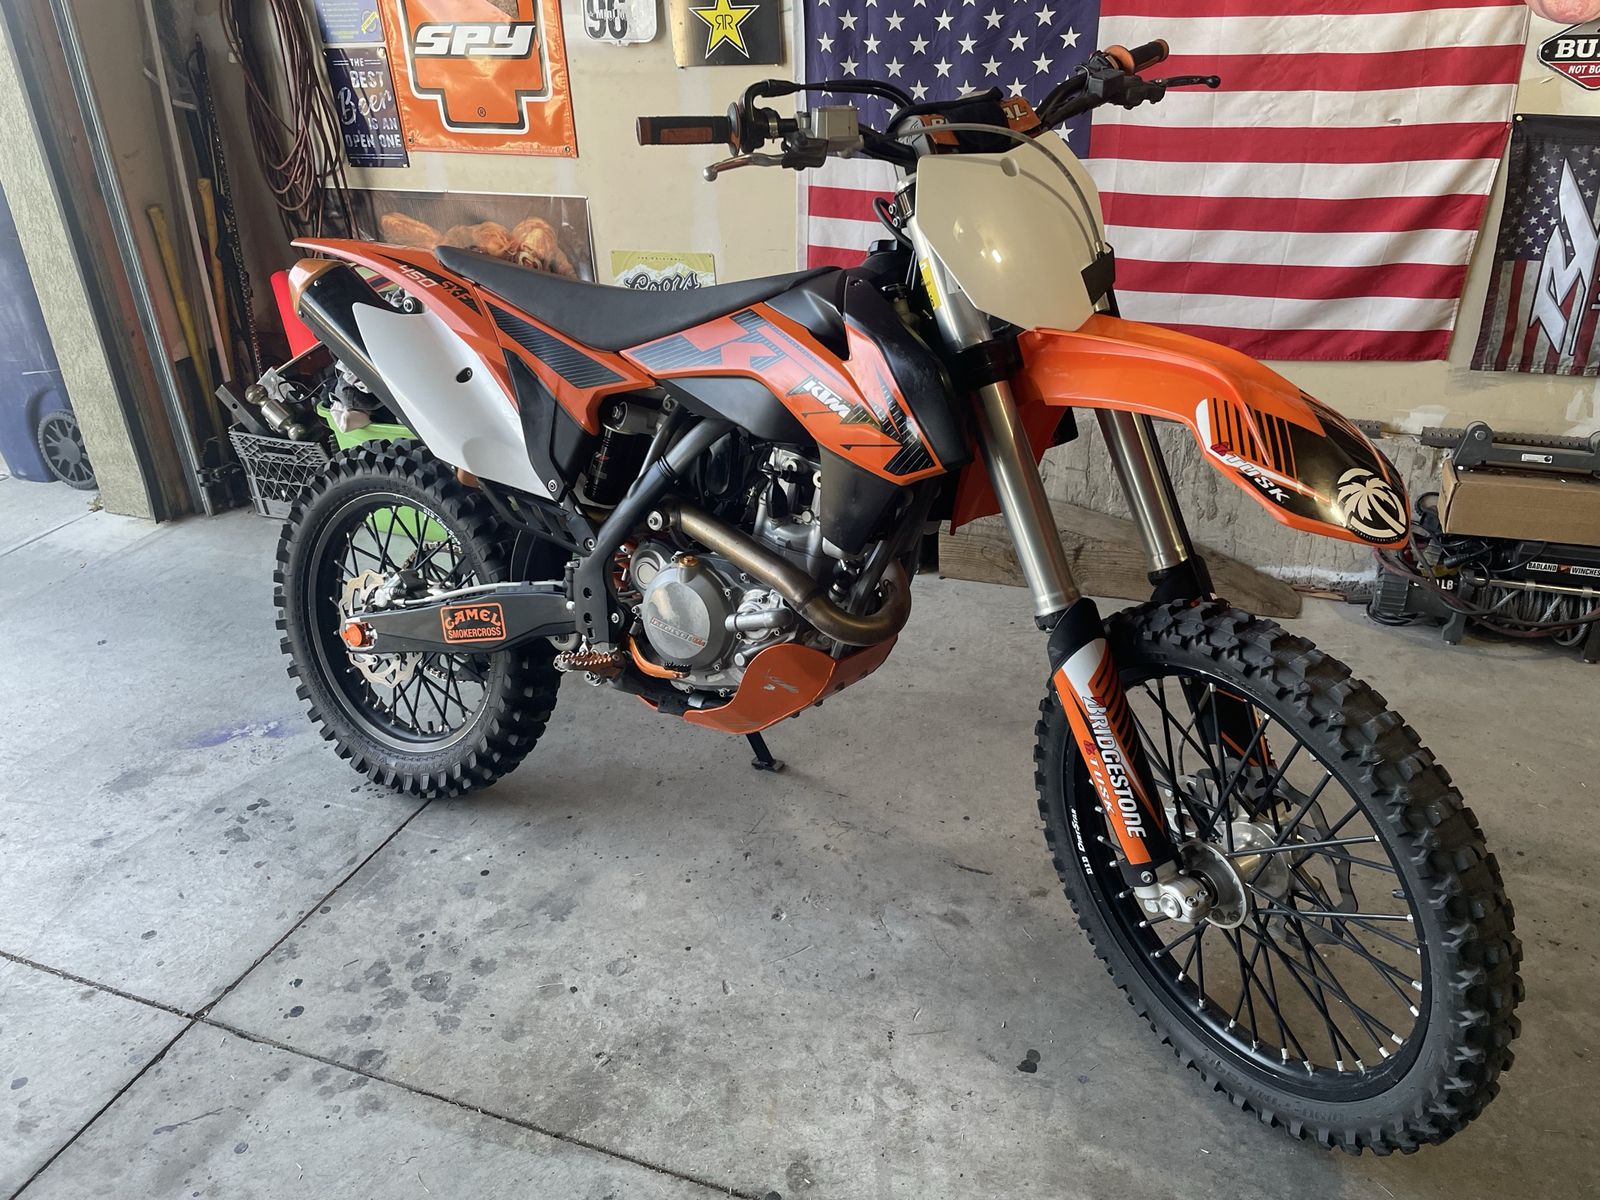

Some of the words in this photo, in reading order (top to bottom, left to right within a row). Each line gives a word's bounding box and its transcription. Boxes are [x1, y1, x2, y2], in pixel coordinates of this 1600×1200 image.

[414, 25, 536, 56] SPY
[1554, 39, 1600, 59] BU
[349, 58, 365, 67] THE
[1568, 65, 1588, 74] NOT
[349, 70, 384, 88] BEST
[337, 86, 392, 126] Beer
[367, 117, 379, 130] IS
[382, 117, 398, 131] AN
[344, 134, 376, 149] OPEN
[378, 134, 402, 149] ONE
[398, 264, 439, 289] 450
[803, 380, 851, 419] KTM
[1226, 453, 1291, 503] TUSK
[1441, 579, 1454, 590] LB
[445, 608, 502, 630] CAMEL
[447, 626, 502, 639] SMOKERCROSS
[1083, 696, 1147, 839] BRIDGESTONE
[1089, 757, 1115, 815] TUSK
